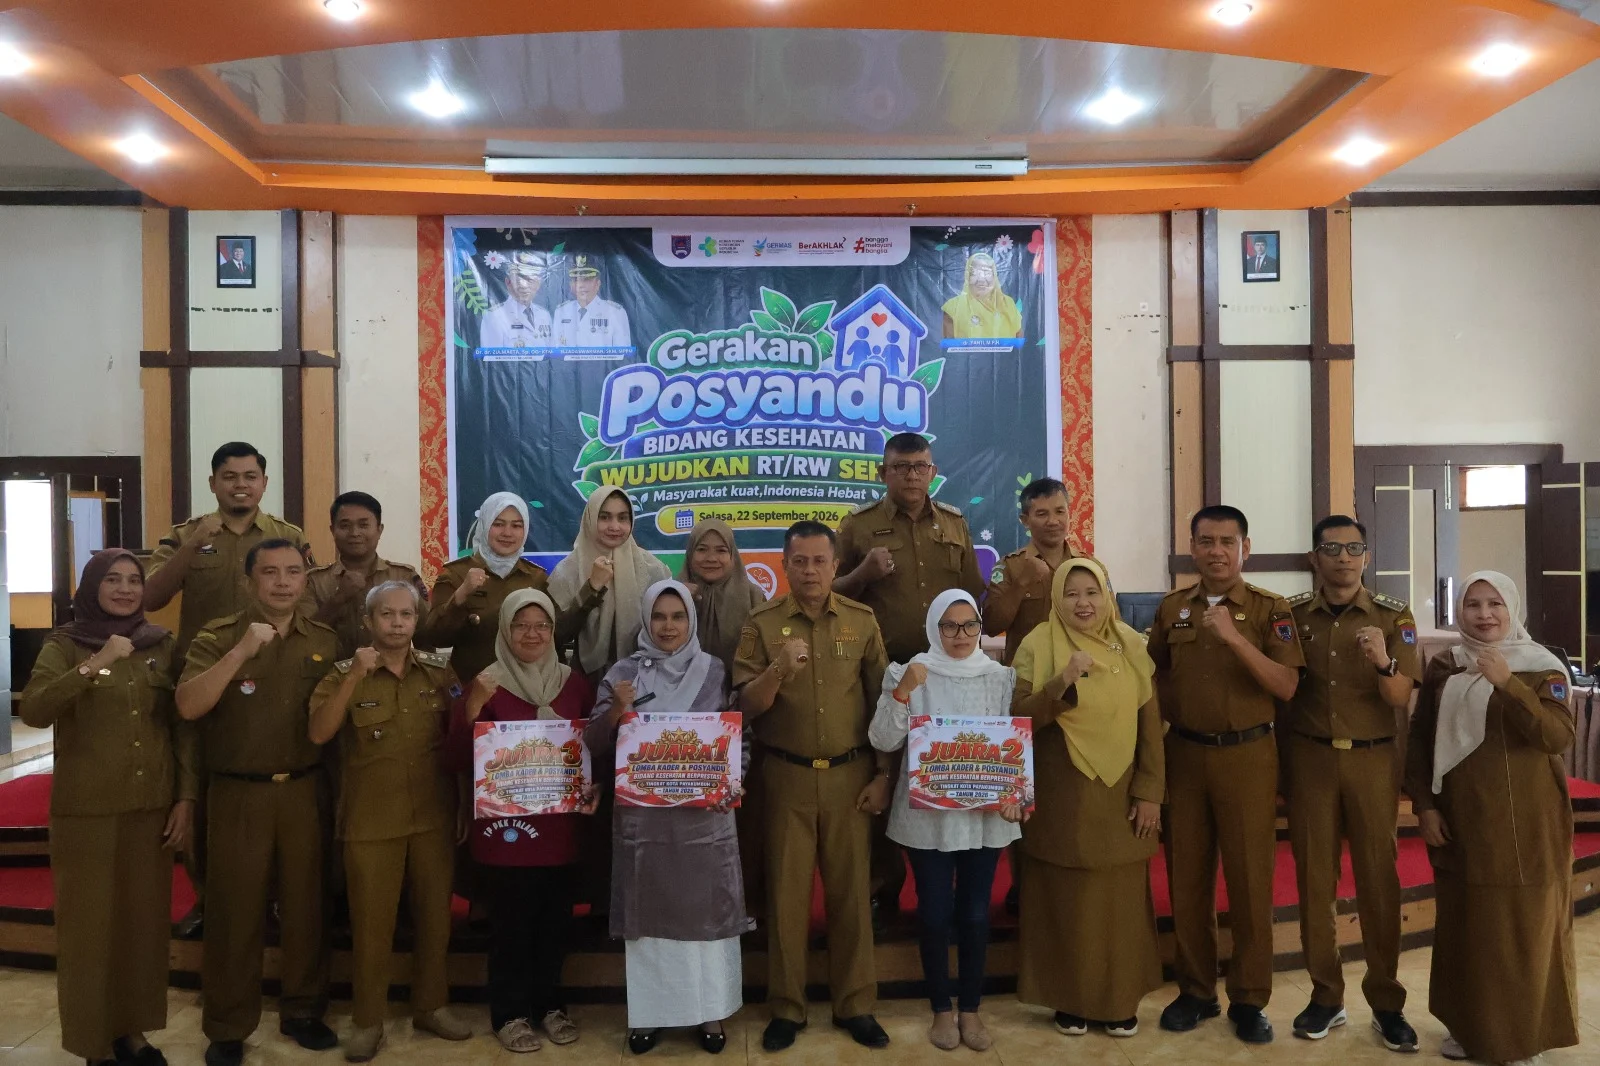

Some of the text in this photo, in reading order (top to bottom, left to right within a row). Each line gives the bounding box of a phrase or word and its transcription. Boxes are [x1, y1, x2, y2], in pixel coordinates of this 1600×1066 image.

[657, 331, 813, 368] Gerakan
[607, 365, 922, 437] Posyandu
[643, 427, 866, 456] BIDANG KESEHATAN
[600, 455, 879, 488] WUJUDKAN RT/RW SEH
[652, 486, 729, 503] Masyarakat
[827, 486, 867, 500] Hebat
[752, 510, 810, 523] September
[811, 511, 839, 522] 2026
[484, 740, 582, 771] JUARA 3
[628, 735, 731, 763] JUARA 1
[918, 738, 1025, 766] JUARA 2
[688, 764, 726, 772] POSYANDU
[924, 764, 950, 773] LOMBA
[951, 764, 974, 772] KADER
[982, 764, 1019, 776] POSYANDU
[484, 819, 540, 839] TP PKK TALANG
